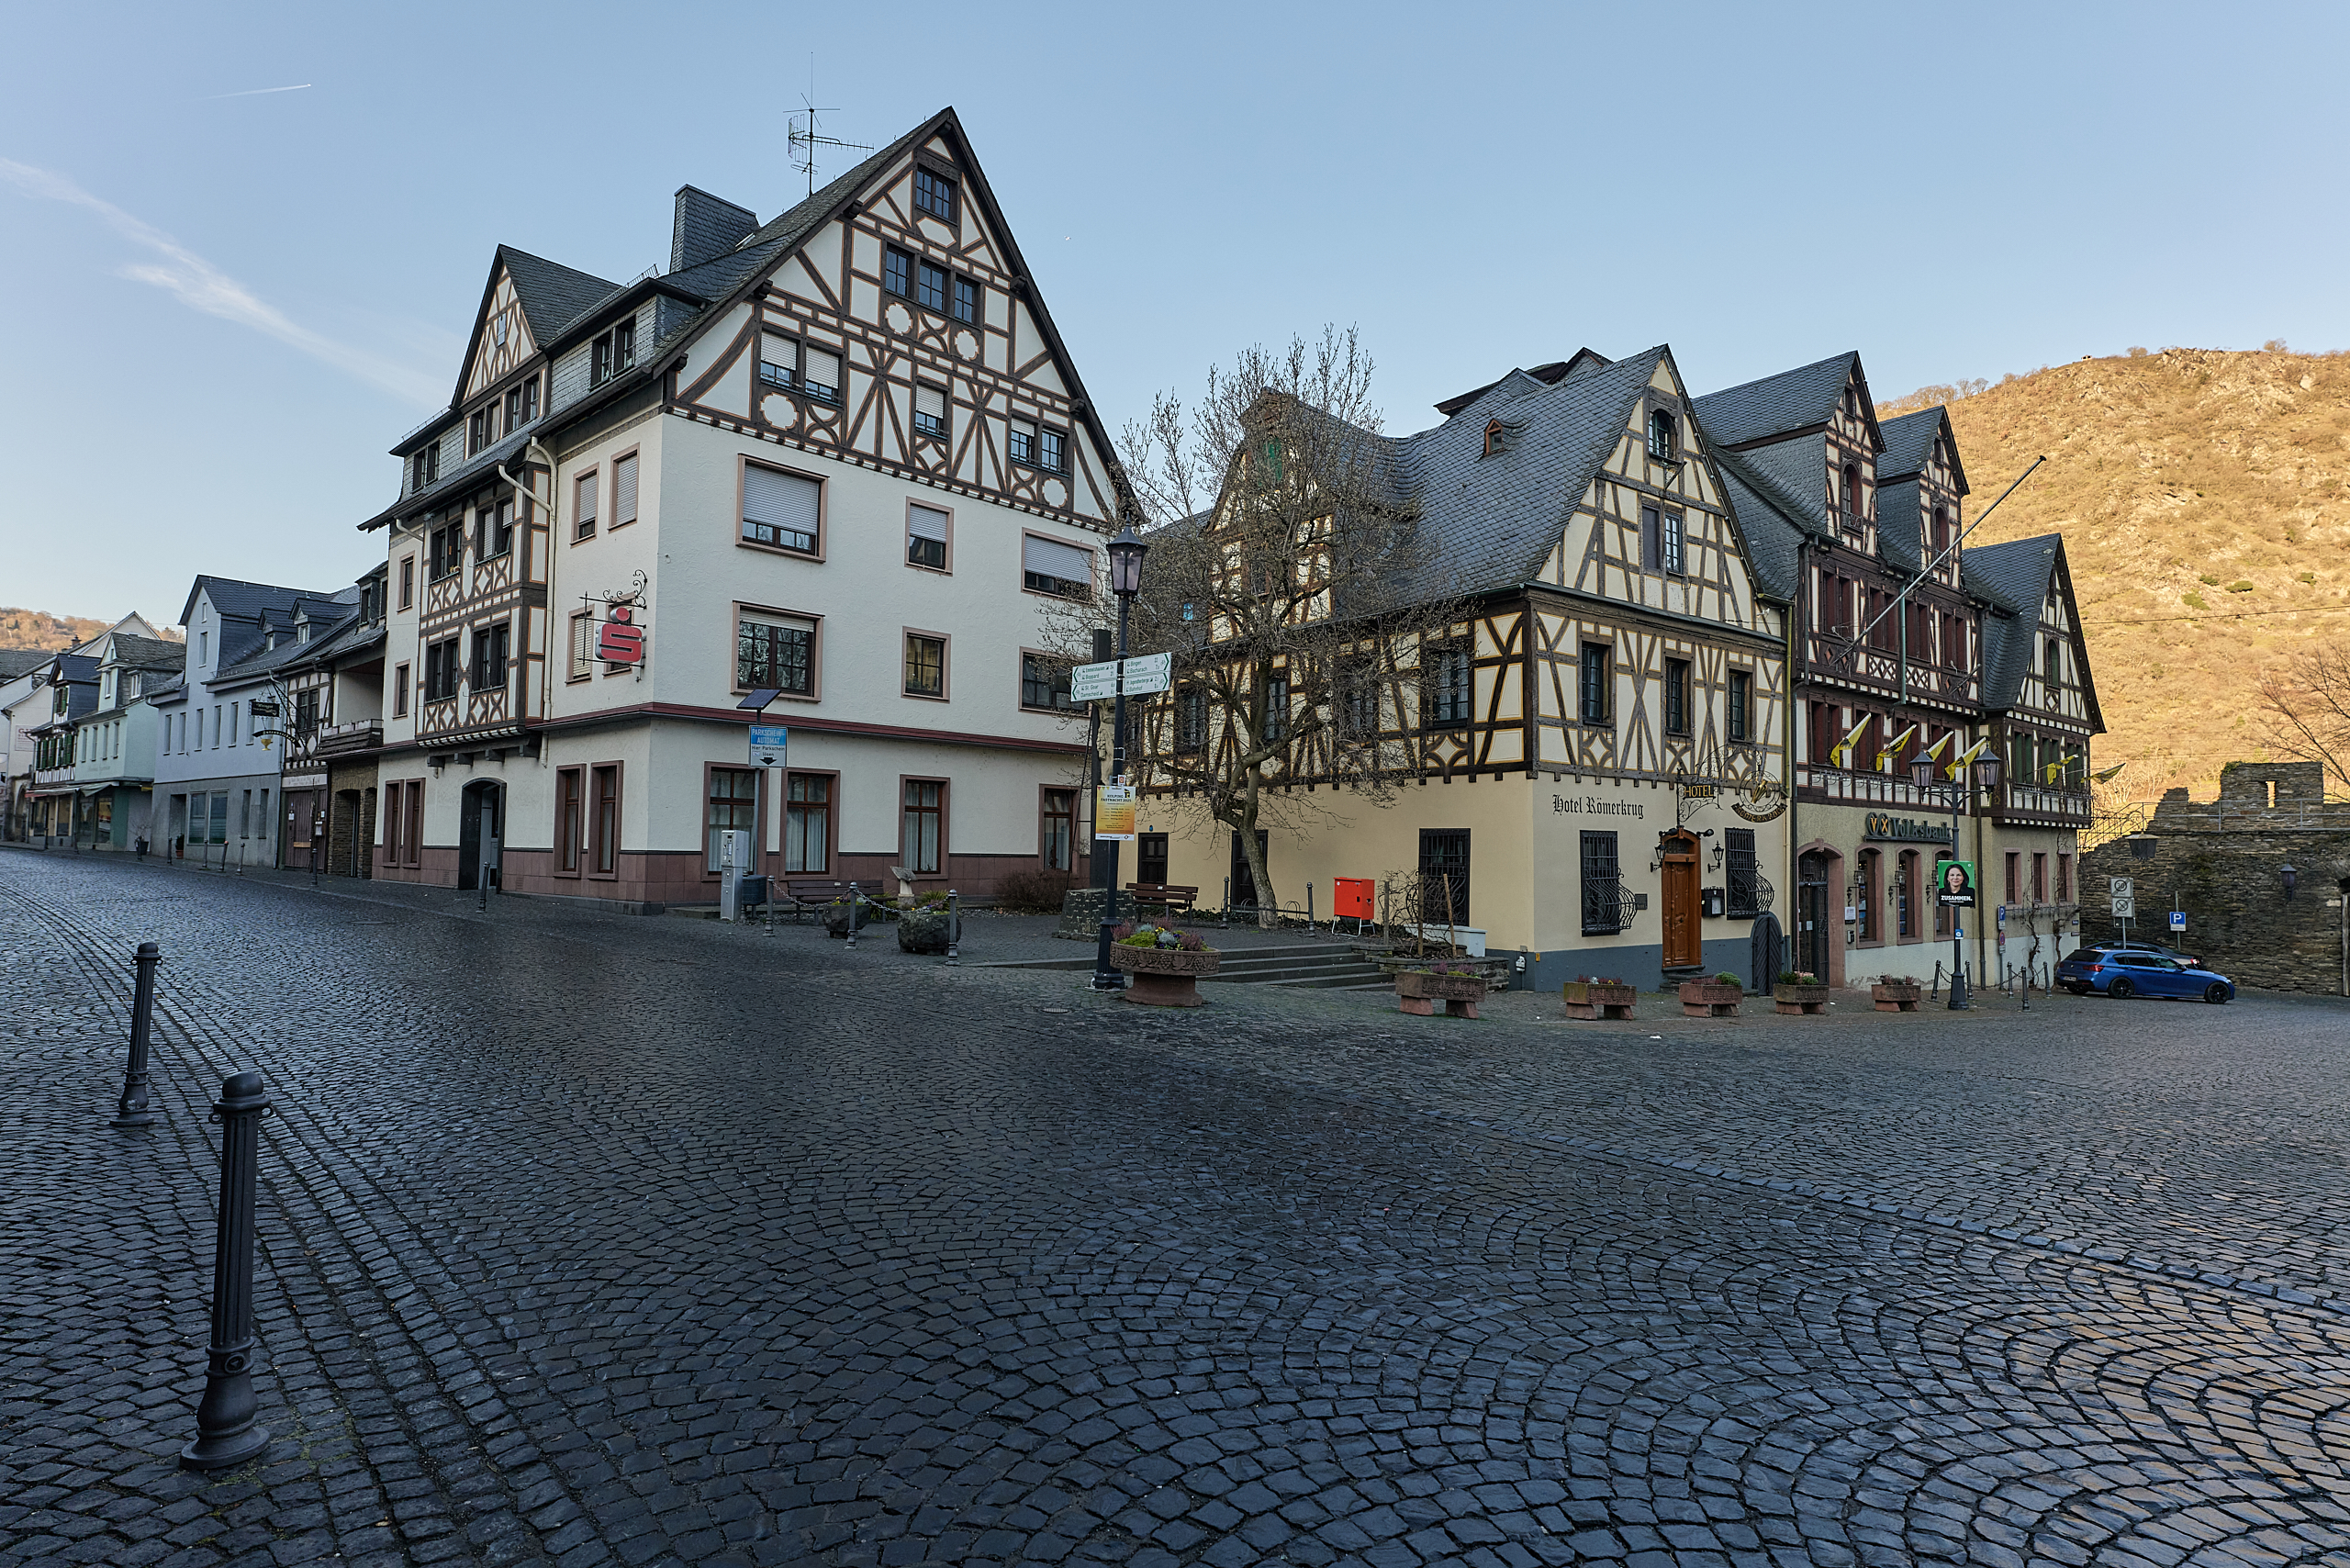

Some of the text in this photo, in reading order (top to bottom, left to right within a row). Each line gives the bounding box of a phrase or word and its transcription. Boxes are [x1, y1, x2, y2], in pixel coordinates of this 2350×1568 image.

[756, 736, 780, 745] AUTOMAT
[1684, 785, 1714, 798] HOTEL
[1552, 793, 1644, 820] Hotel Römerkrug
[1889, 816, 1953, 839] Volksbank
[2173, 913, 2182, 924] P
